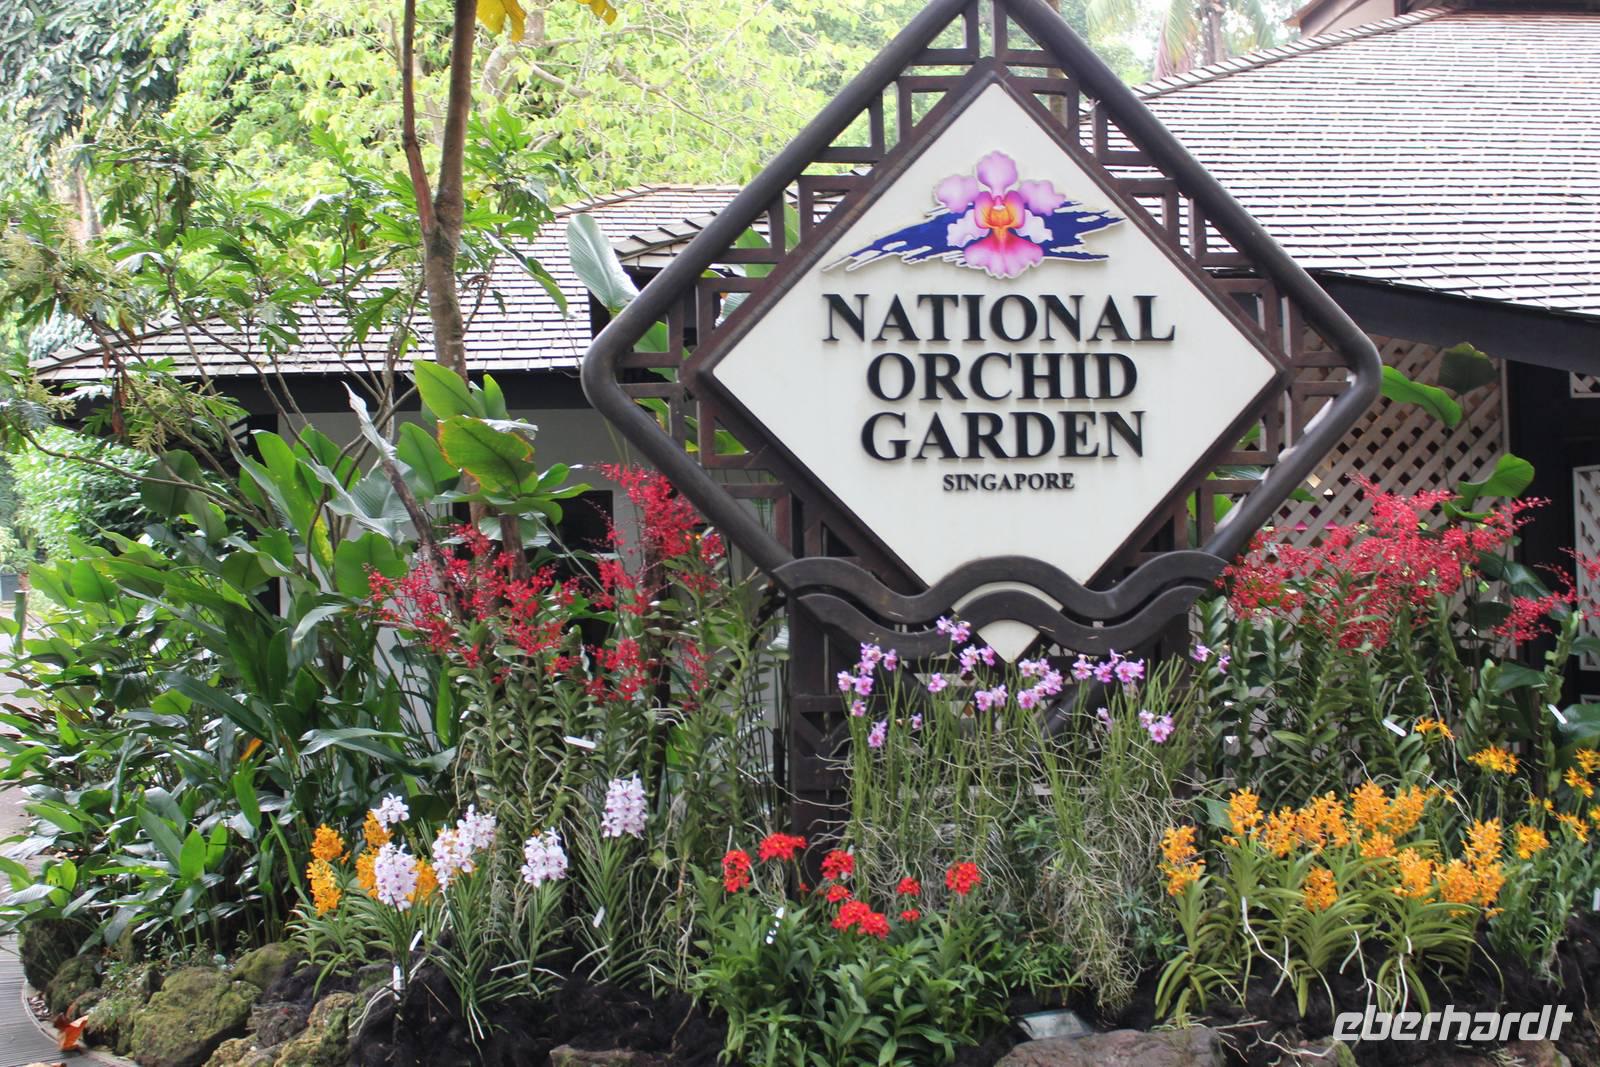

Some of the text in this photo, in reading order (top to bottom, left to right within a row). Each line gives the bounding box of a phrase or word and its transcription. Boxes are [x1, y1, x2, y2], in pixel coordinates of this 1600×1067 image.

[822, 294, 1175, 342] NATIONAL
[867, 352, 1138, 401] ORCHID
[861, 411, 1146, 461] GARDEN
[943, 473, 1075, 491] SINGAPORE
